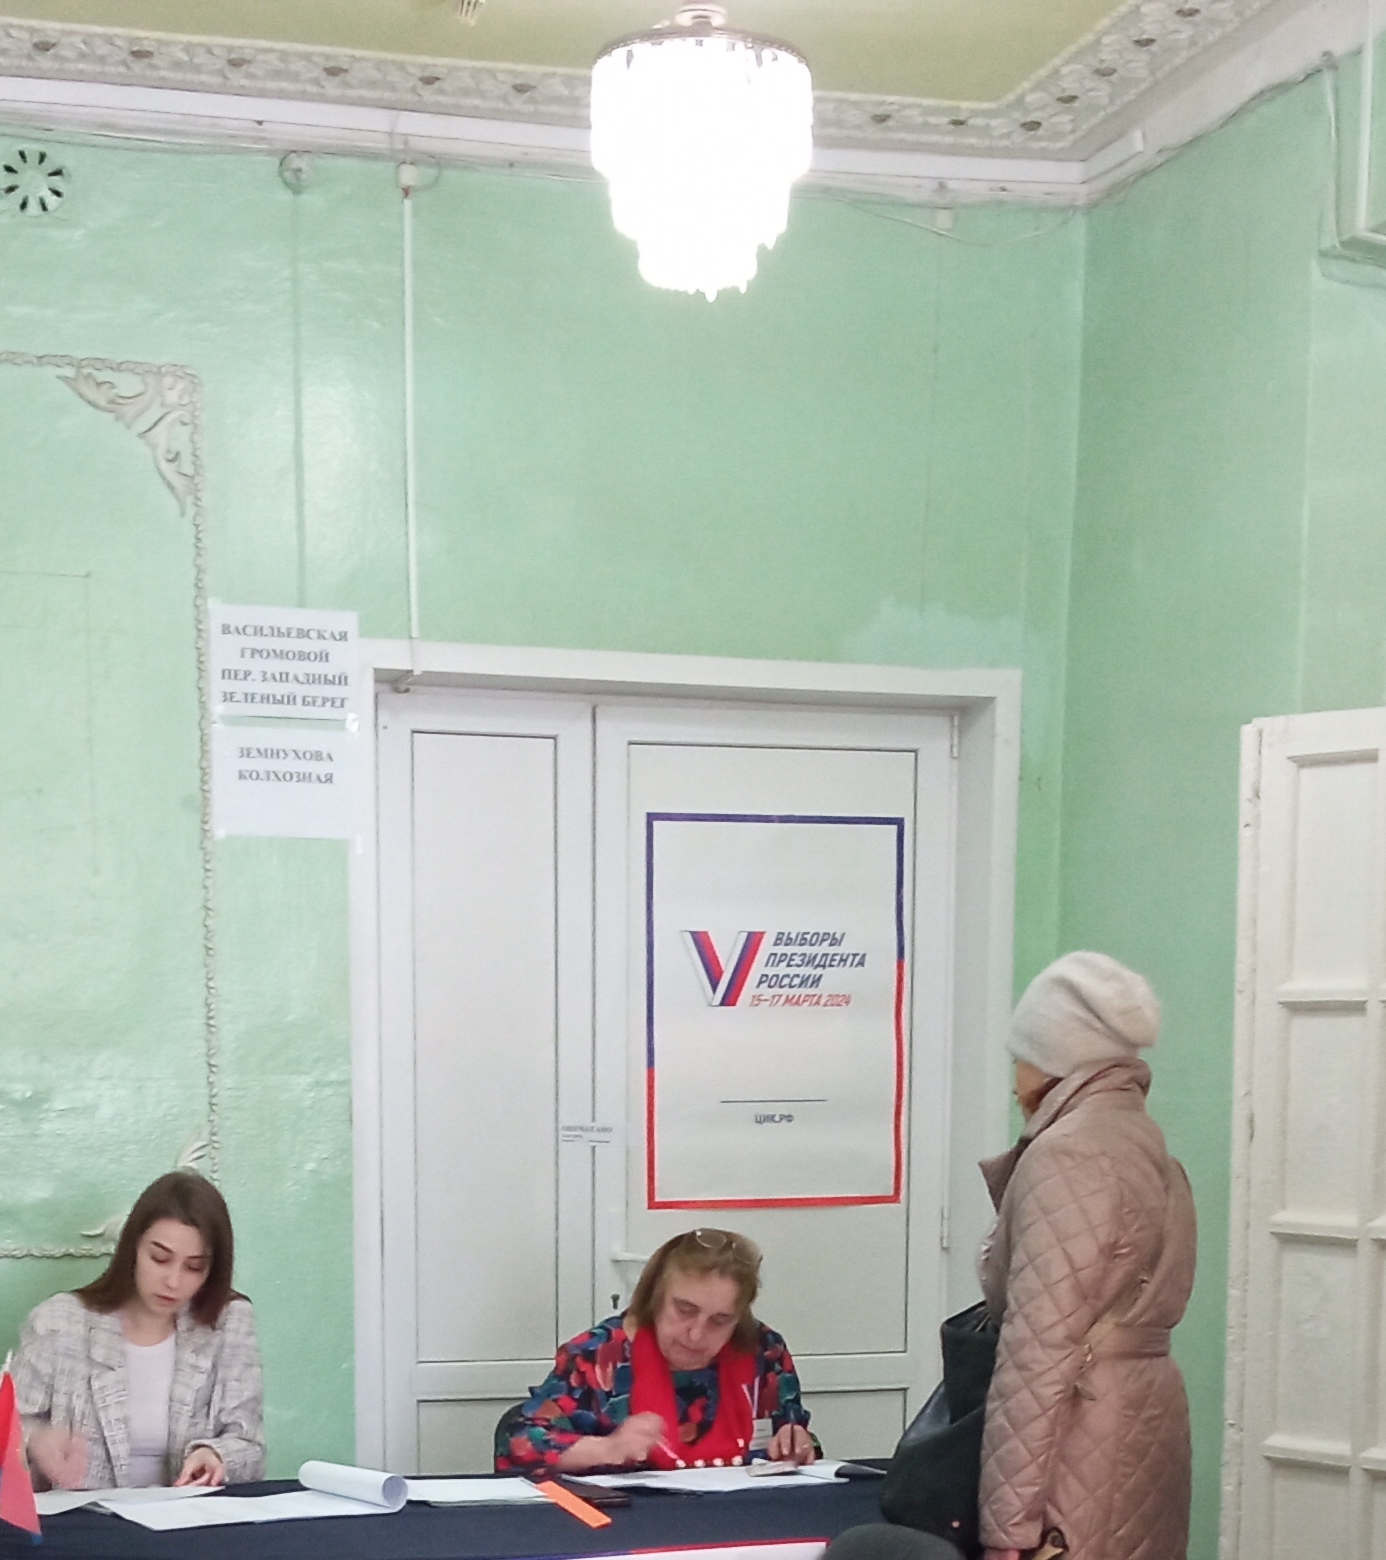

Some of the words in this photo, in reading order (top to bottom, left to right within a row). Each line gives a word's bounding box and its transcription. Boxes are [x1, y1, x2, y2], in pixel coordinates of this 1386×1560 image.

[221, 622, 348, 642] ВАСИЛЬЕВСКАЯ
[239, 647, 330, 664] ГРОМОВОЙ
[221, 668, 255, 683] ПЕР.
[260, 669, 349, 687] ЗАПАДНЫЙ
[221, 690, 297, 707] ЗЕЛЕНЫЙ
[300, 694, 348, 709] БЕРЕГ
[238, 746, 334, 763] ЗЕМНУХОВА
[237, 769, 335, 785] КОЛХОЗНАЯ
[772, 931, 847, 948] ВЫБОРЫ
[763, 952, 868, 970] ПРЕЗИДЕНТА
[755, 973, 824, 989] РОССИИ
[781, 994, 821, 1008] МАРТА
[822, 994, 852, 1008] 2024
[754, 1113, 795, 1125] ЦИК.РФ
